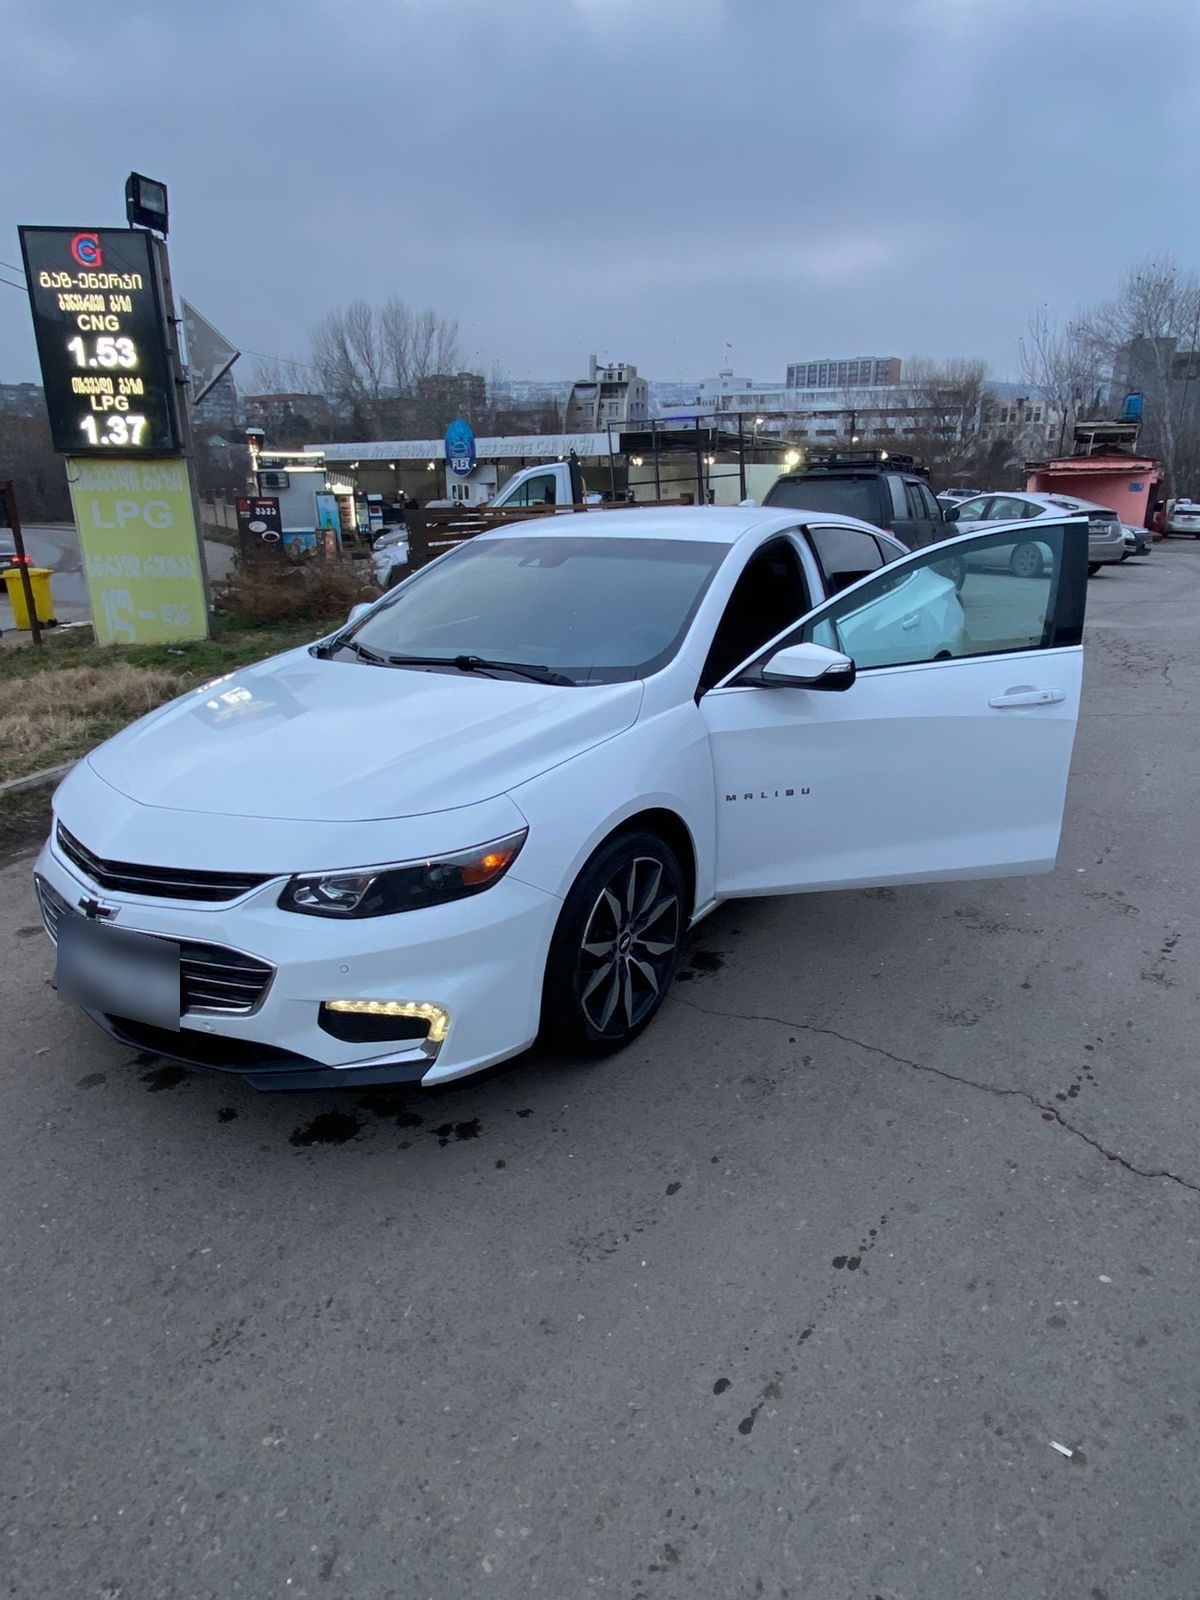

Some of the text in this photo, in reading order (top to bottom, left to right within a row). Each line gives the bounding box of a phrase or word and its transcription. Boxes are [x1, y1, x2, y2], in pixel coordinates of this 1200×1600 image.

[109, 294, 132, 312] გაზი
[77, 315, 119, 331] CNG
[67, 336, 137, 369] 1.53
[118, 377, 143, 395] გაზი
[90, 395, 129, 411] LPG
[80, 415, 146, 445] 1.37
[537, 440, 559, 454] CAR
[452, 459, 470, 470] FLEX
[91, 499, 174, 529] LPG
[725, 787, 810, 801] MALIBU
